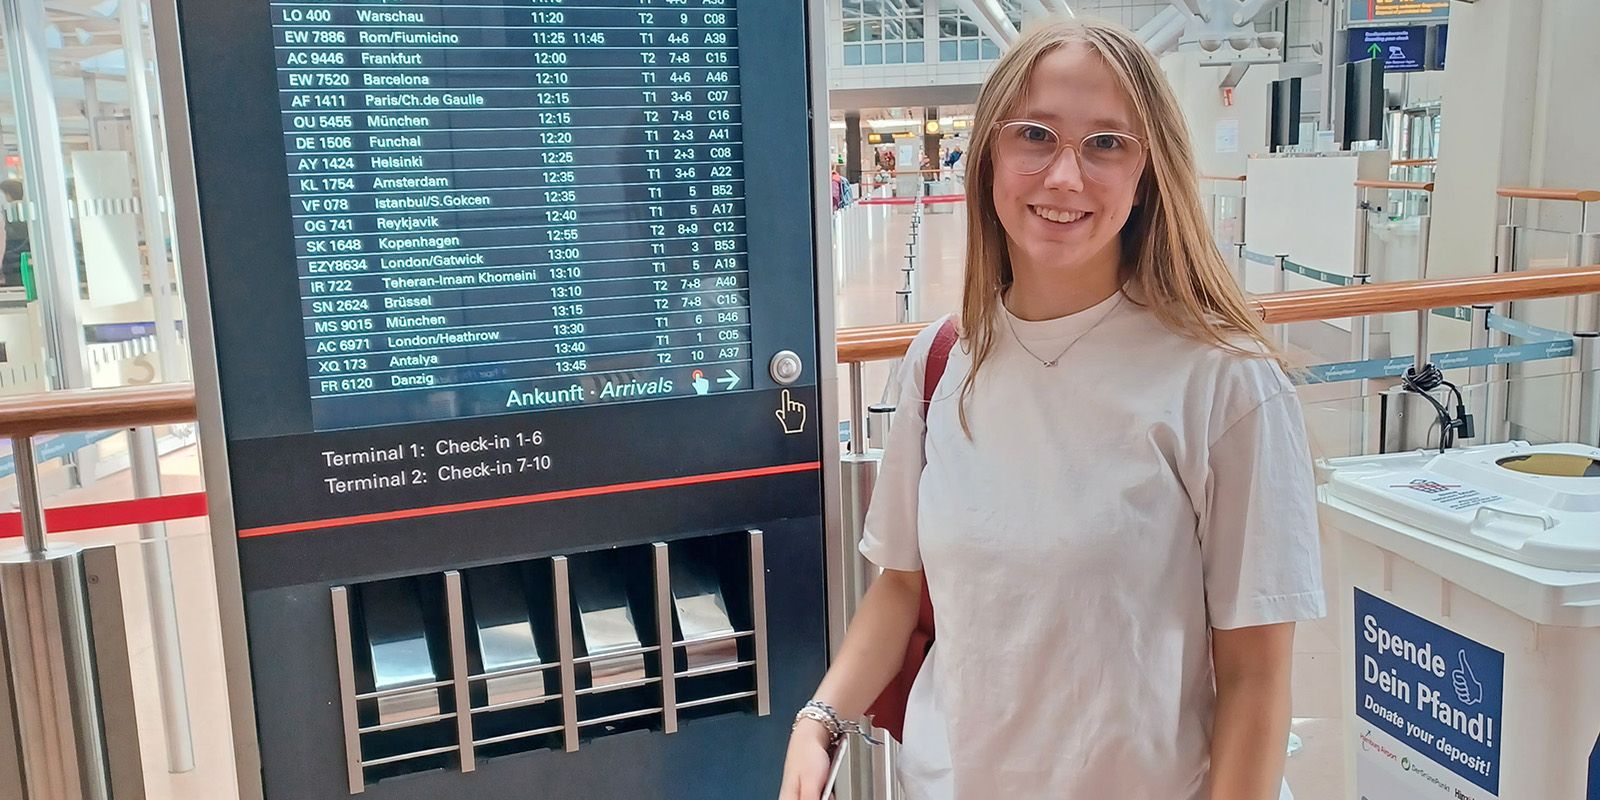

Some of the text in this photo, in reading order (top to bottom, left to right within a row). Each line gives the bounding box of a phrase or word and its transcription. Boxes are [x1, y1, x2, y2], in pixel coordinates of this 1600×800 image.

[283, 10, 725, 24] LO 400 Warschau 11:20 T2 9 C08
[285, 31, 726, 44] EW 7886 Rom/Fiumicino 11:25 11:45 T1 4+6 A39
[287, 52, 727, 64] AC 9446 Frankfurt 12:00 T2 7+8 C15
[290, 72, 728, 86] EW 7520 Barcelona 12:10 T1 4+6 A46
[292, 91, 728, 107] AF 1411 Paris/Ch.de Gaulle 12:15 T1 3+6 C07
[294, 110, 729, 128] OU 5455 München 12:15 T2 7+8 C16
[296, 129, 728, 149] DE 1506 Funchal 12:20 T1 2+3 A41
[298, 148, 731, 170] AY 1424 Helsinki 12:25 T1 2+3 C08
[300, 166, 732, 190] KL 1754 Amsterdam 12:35 T1 3+6 A22
[302, 185, 732, 211] VF 078 Istanbul/S.Gokcen 12:35 T1 5 B52
[305, 203, 733, 232] OG 741 Reykjavik 12:40 T1 5 A17
[307, 222, 734, 252] SK 1648 Kopenhagen 12:55 T2 8+9 C12
[309, 240, 735, 272] EZY8634 London/Gatwick 13:00 T1 3 B53
[311, 258, 736, 292] IR 722 Teheran-Imam Khomeini 13:10 T1 5 A19
[313, 276, 736, 312] SN 2624 Brüssel 13:10 T2 7+8 A40
[315, 294, 737, 332] MS 9015 München 13:15 T2 7+8 C15
[317, 312, 738, 352] AC 6971 London/Heathrow 13:30 T1 6 B46
[319, 330, 739, 372] XQ 173 Antalya 13:40 T1 1 C05
[321, 348, 739, 392] FR 6120 Danzig 13:45 T2 10 A37
[506, 377, 672, 407] Ankunft Arrivals
[322, 430, 543, 467] Terminal 1: Check-in 1-6
[324, 455, 551, 494] Terminal 2: Check-in 7-10
[1364, 614, 1446, 678] Spende
[1364, 654, 1493, 748] Dein Pfand!
[1364, 694, 1492, 777] Donate your deposit!
